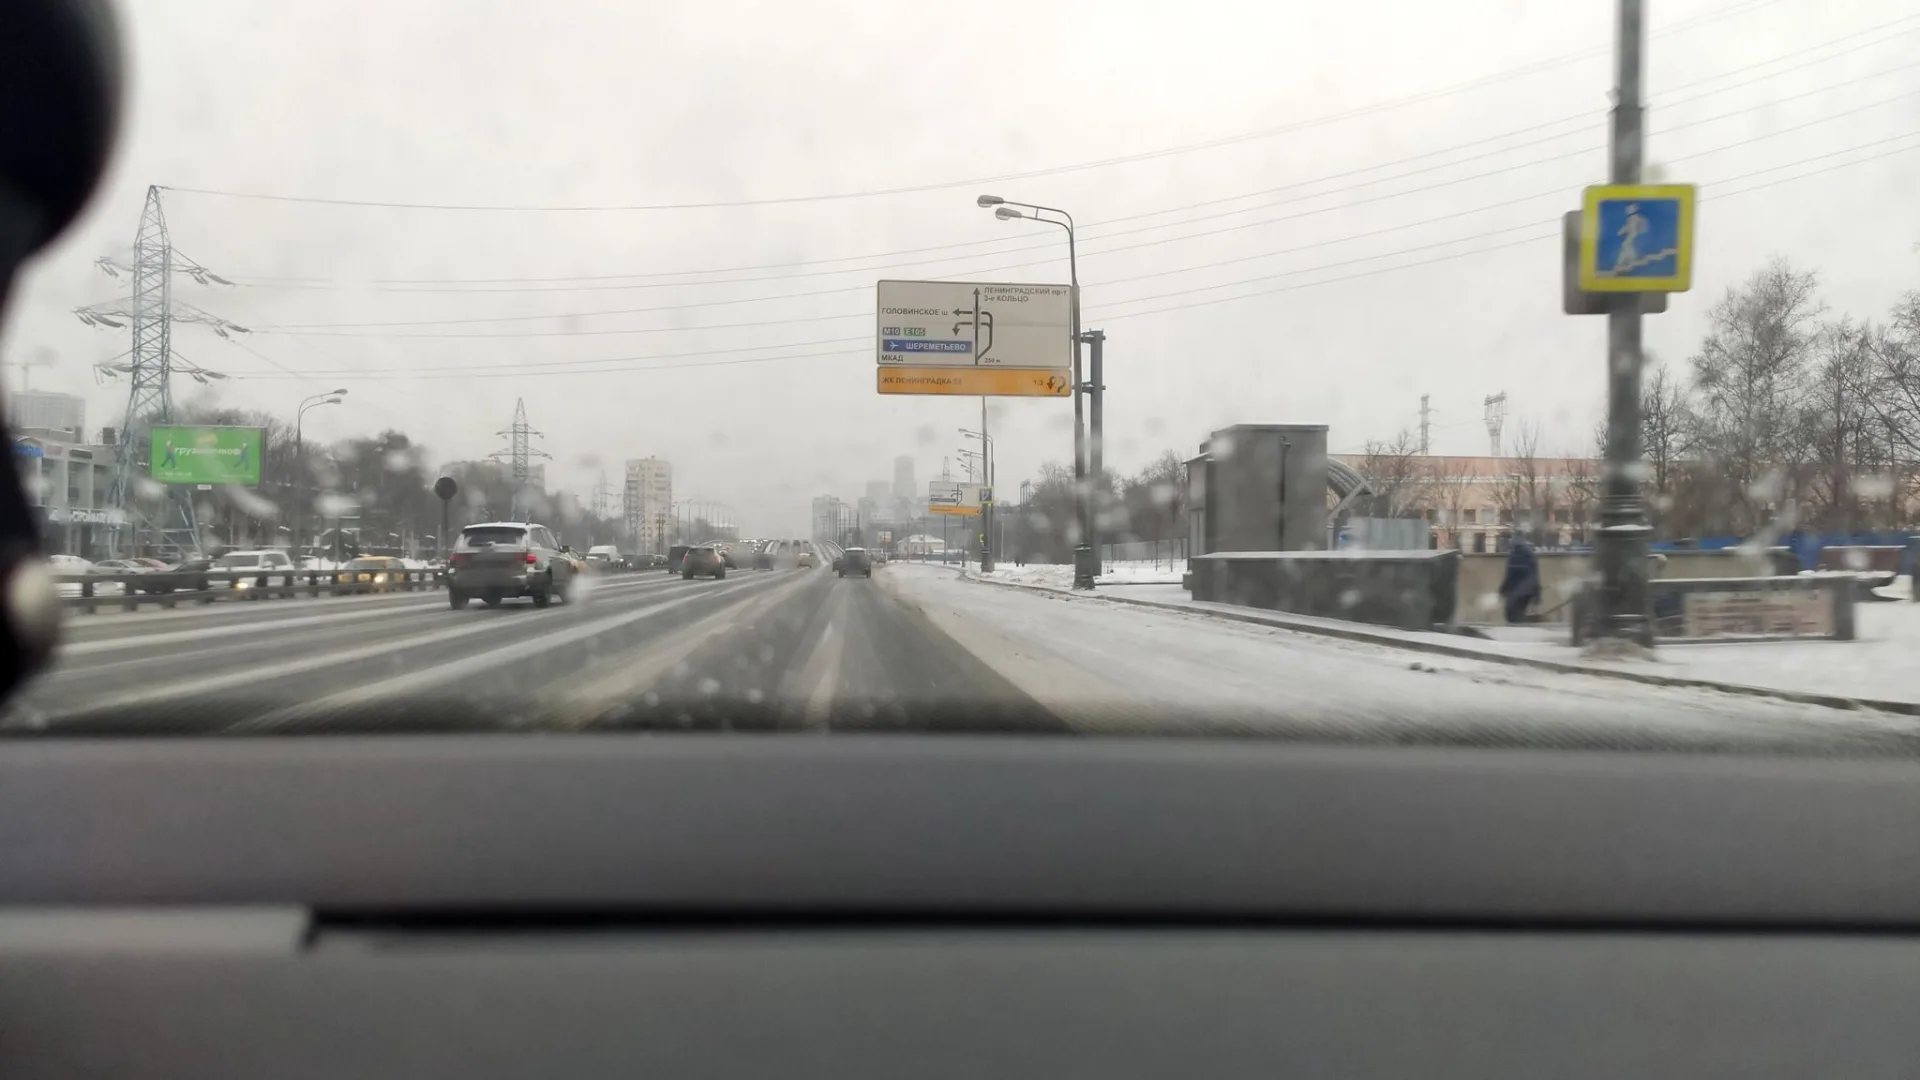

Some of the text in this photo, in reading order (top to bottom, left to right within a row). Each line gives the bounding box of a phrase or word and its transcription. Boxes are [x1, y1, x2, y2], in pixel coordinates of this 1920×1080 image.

[984, 287, 1050, 295] ЛЕНИНГРАДСКИЙ
[996, 295, 1029, 303] КОЛЬЦО
[882, 307, 939, 316] ГОЛОВИНСКОЕ
[906, 342, 966, 351] ШЕРЕМЕТЬЕВО
[882, 354, 904, 362] МКАД
[896, 376, 952, 385] ЛЕНИНГРАДКА
